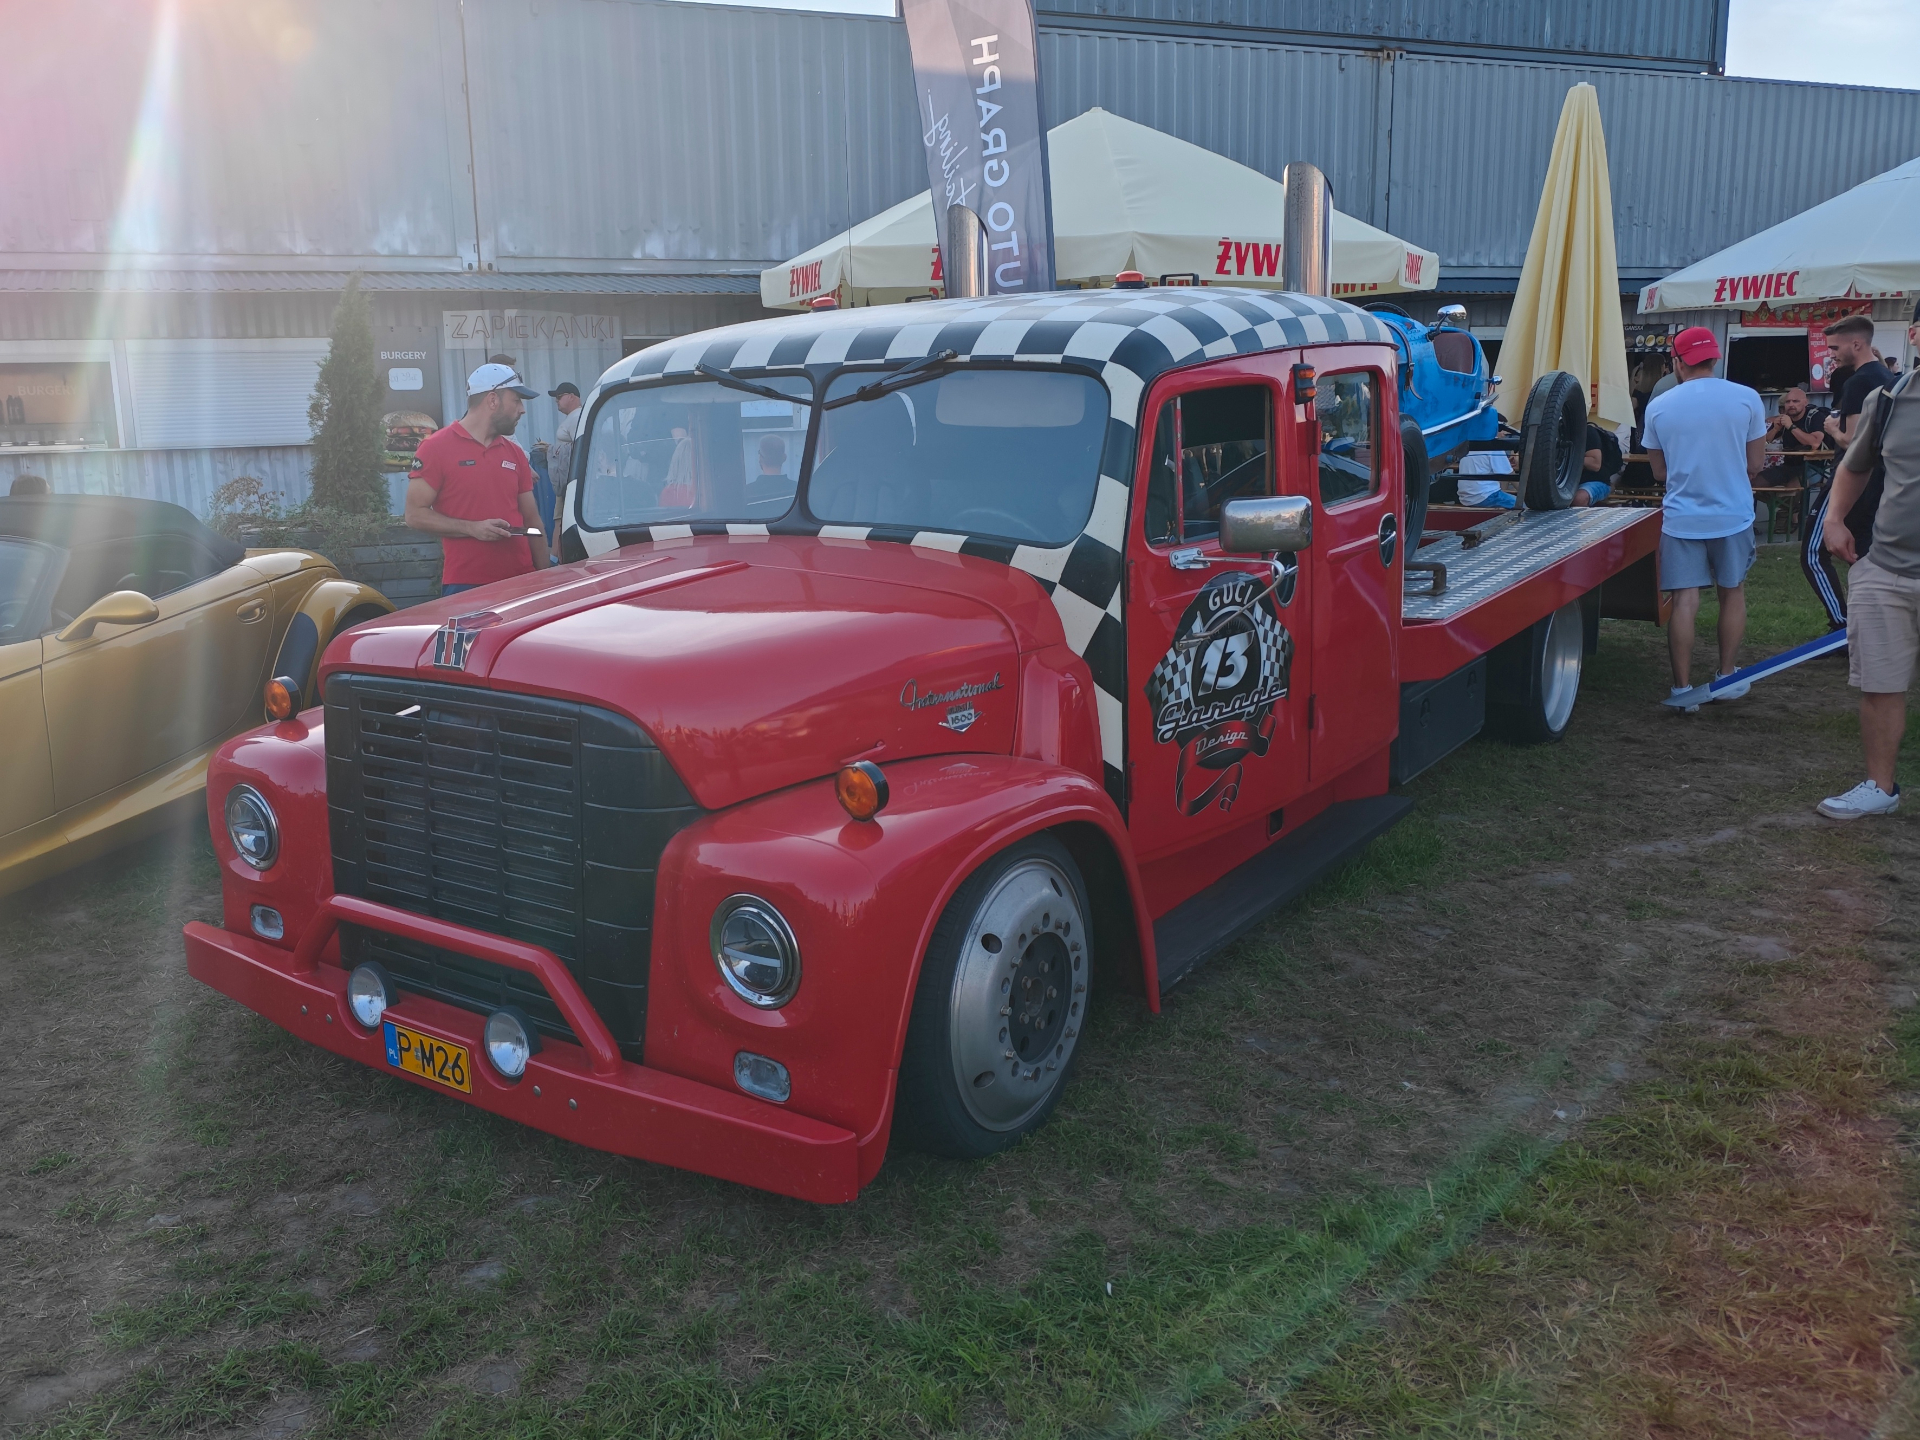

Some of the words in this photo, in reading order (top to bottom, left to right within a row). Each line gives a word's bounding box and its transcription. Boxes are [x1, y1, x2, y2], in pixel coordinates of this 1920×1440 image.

[1215, 237, 1282, 277] ŻYW
[789, 259, 823, 298] ŻYWIEC
[1713, 270, 1800, 303] ŻYWIEC
[450, 315, 614, 339] ZAPIEKANKI
[380, 351, 427, 360] BURGERY
[17, 385, 77, 396] BURGERY
[1208, 581, 1253, 611] GUCI
[1198, 629, 1255, 697] 13
[900, 671, 1005, 711] International
[1156, 680, 1287, 744] Garage
[1195, 729, 1248, 756] Design
[388, 1047, 398, 1060] PL
